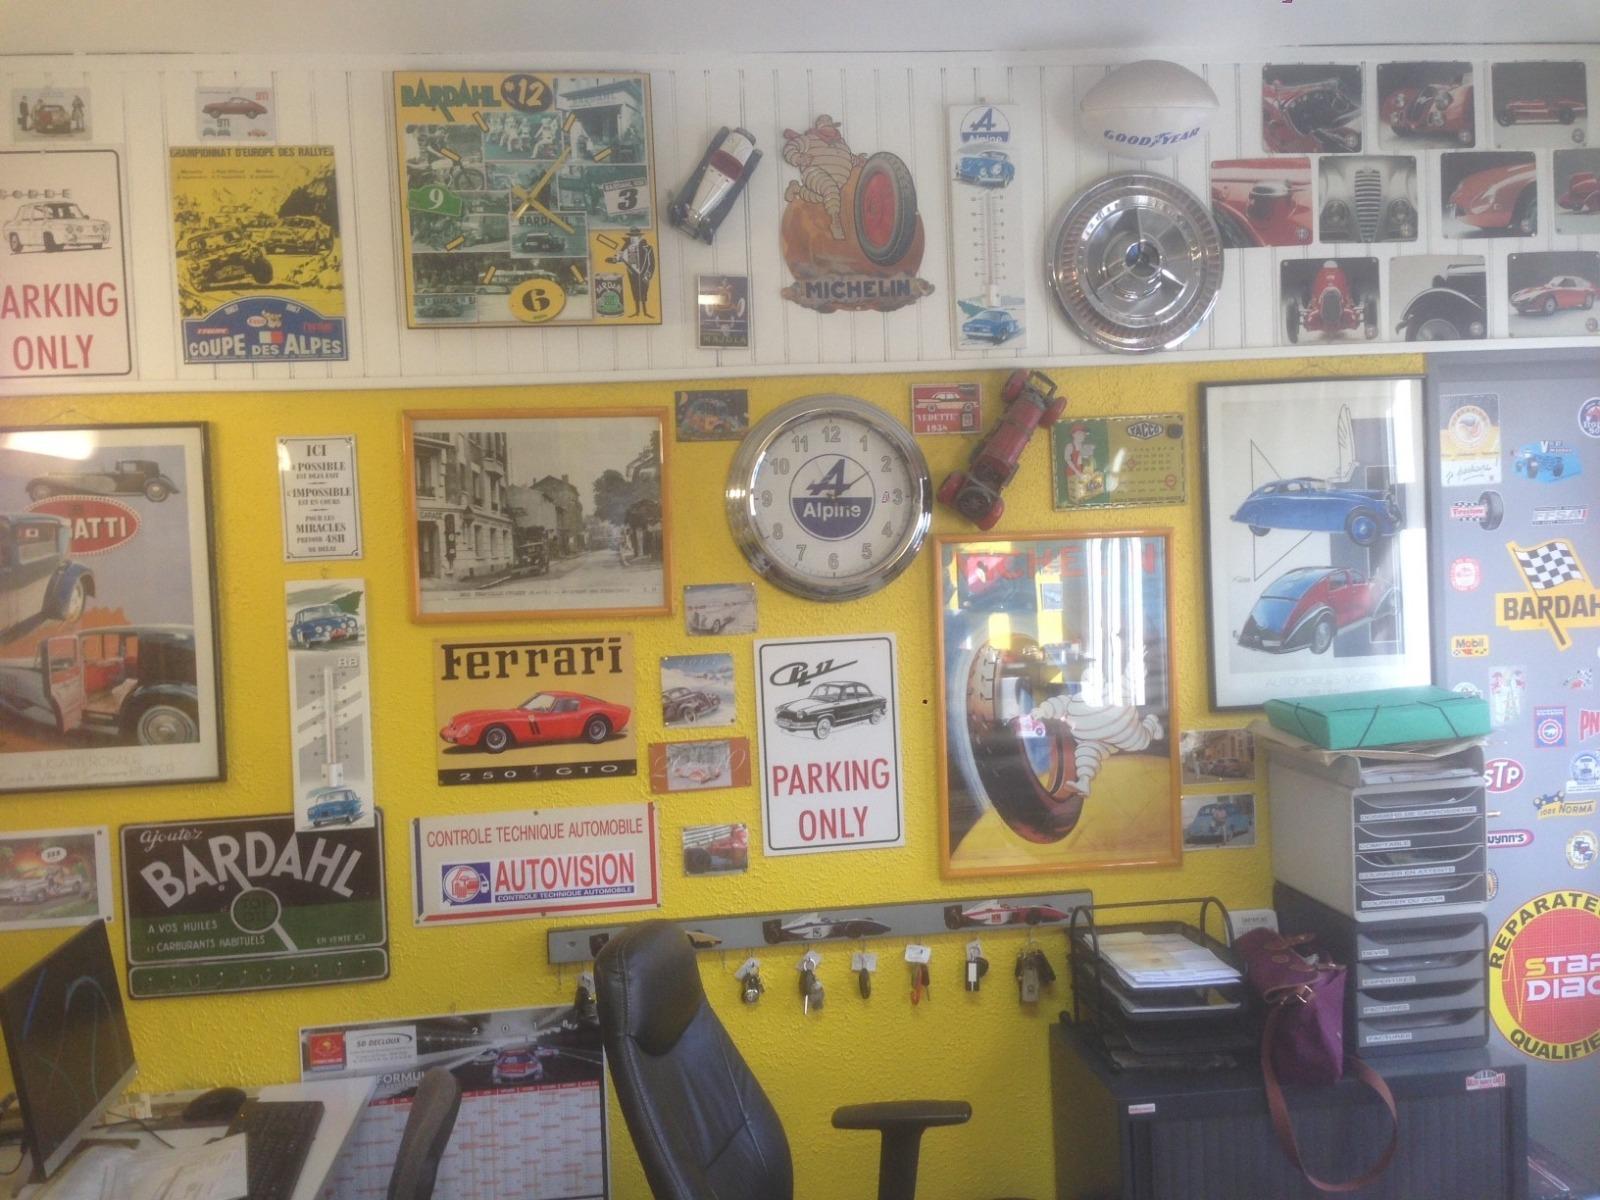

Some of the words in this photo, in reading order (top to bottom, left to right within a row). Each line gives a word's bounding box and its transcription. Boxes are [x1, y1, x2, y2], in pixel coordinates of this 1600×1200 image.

[401, 77, 501, 121] BARDAHL
[428, 189, 444, 209] 9
[618, 188, 638, 211] 3
[805, 279, 911, 299] MICHELIN
[522, 289, 551, 313] 6
[13, 335, 94, 371] ONLY
[189, 334, 246, 357] COUPE
[252, 345, 280, 355] DES
[284, 333, 342, 355] ALPES
[822, 426, 841, 442] 12
[1130, 423, 1160, 438] YACCO
[307, 445, 327, 456] ICI
[792, 435, 808, 452] 11
[860, 435, 868, 452] 1
[298, 462, 346, 472] POSSIBLE
[770, 458, 790, 475] 10
[881, 456, 892, 472] 2
[761, 490, 772, 507] 9
[892, 488, 903, 505] 3
[803, 502, 861, 521] Alpine
[66, 517, 127, 539] ATTI
[296, 523, 346, 533] MIRACLES
[772, 523, 784, 540] 8
[881, 521, 892, 538] 4
[796, 544, 806, 561] 7
[862, 543, 872, 559] 5
[828, 553, 839, 569] 6
[1455, 638, 1484, 649] Mobil
[441, 637, 623, 680] Ferrari
[459, 770, 517, 781] 250
[556, 765, 618, 776] GTO
[772, 758, 890, 797] PARKING
[1484, 761, 1521, 788] STP
[799, 806, 868, 842] ONLY
[426, 827, 492, 848] CONTROLE
[497, 823, 565, 843] TECHNIQUE
[569, 818, 643, 838] AUTOMOBILE
[140, 831, 362, 908] BARDAHL
[495, 852, 635, 892] AUTOVISION
[584, 886, 633, 896] AUTOMOBILE
[159, 923, 178, 933] VOS
[183, 920, 218, 931] HUILES
[1490, 893, 1600, 970] REPARATE
